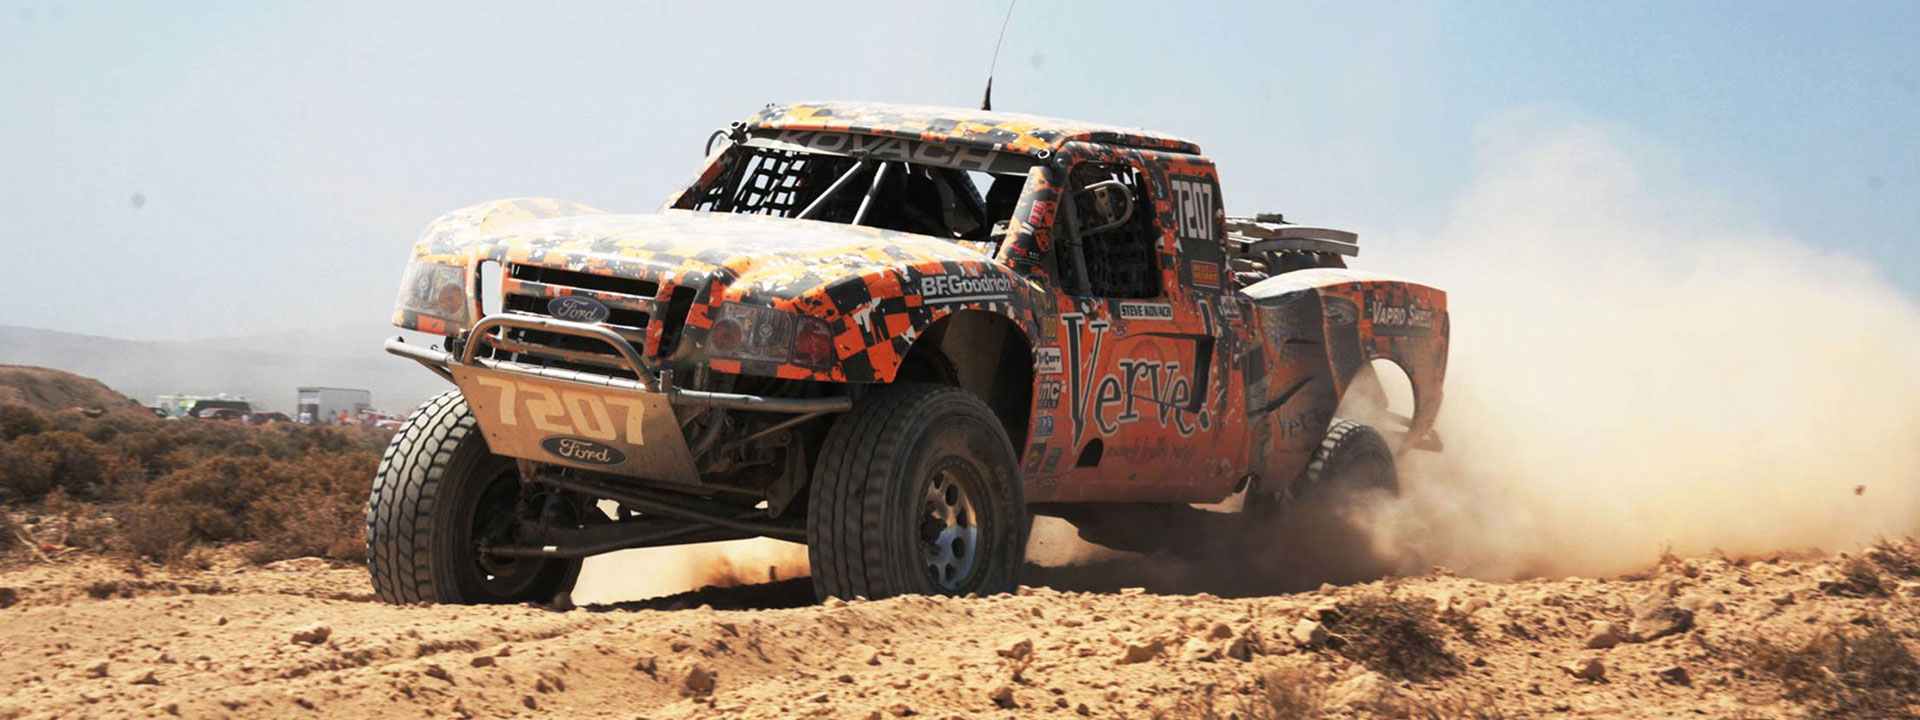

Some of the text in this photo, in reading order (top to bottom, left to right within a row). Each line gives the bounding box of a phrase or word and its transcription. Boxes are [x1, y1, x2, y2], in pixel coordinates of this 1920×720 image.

[776, 130, 997, 171] KOVACH
[1171, 179, 1213, 241] 7207
[557, 298, 598, 321] Ford
[1121, 304, 1172, 318] STEVE KOVACH
[1061, 299, 1215, 456] Verve!
[477, 375, 646, 446] 7207
[558, 438, 612, 463] Ford
